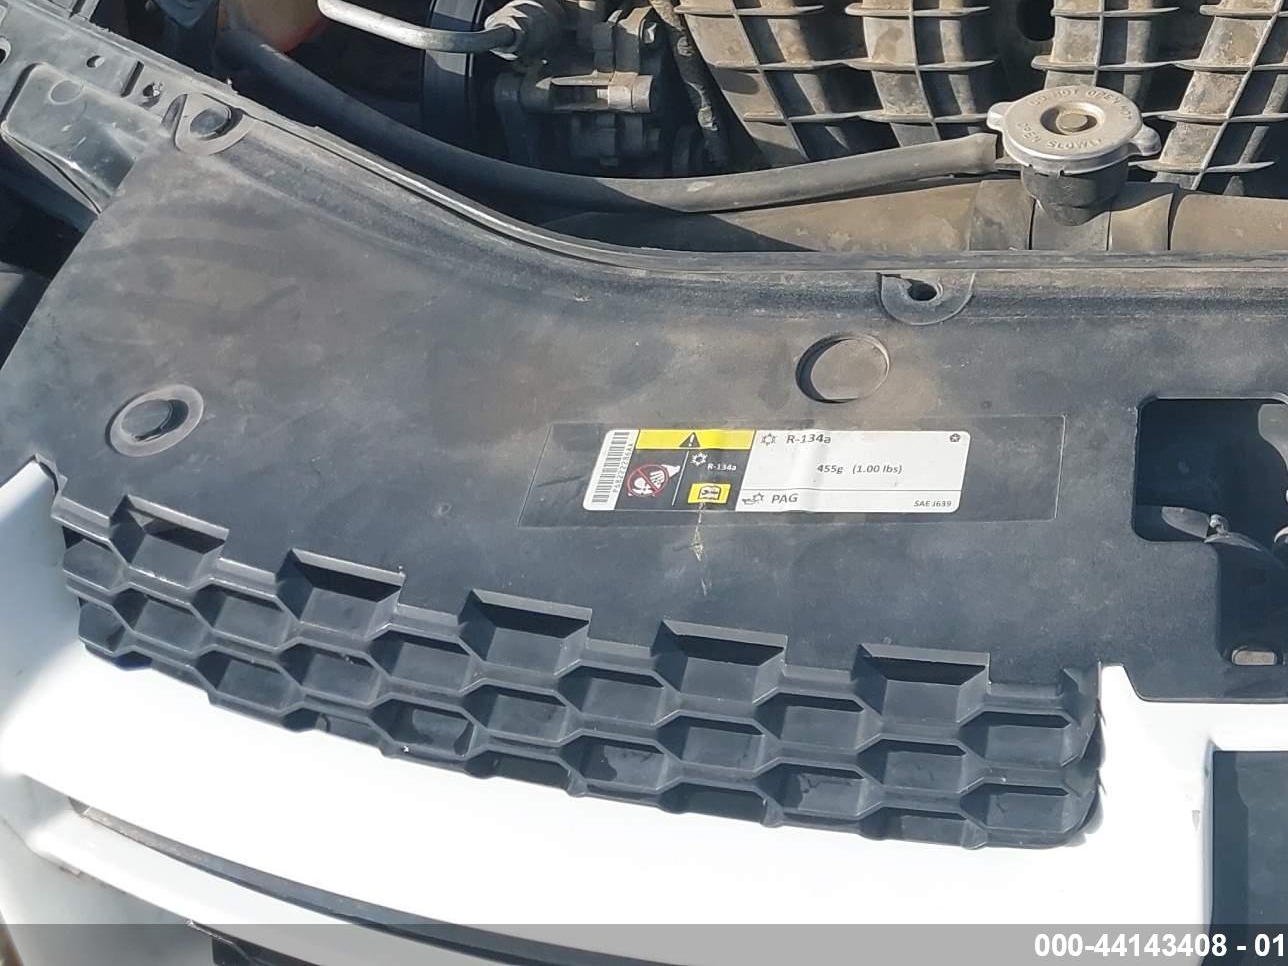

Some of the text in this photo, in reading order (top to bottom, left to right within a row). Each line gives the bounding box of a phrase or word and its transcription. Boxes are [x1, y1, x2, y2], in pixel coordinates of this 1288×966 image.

[786, 433, 832, 444] R-134a
[706, 463, 738, 472] R-134a
[816, 464, 904, 475] 455g (1.00 lbs)
[771, 493, 952, 508] PAG SAE J639
